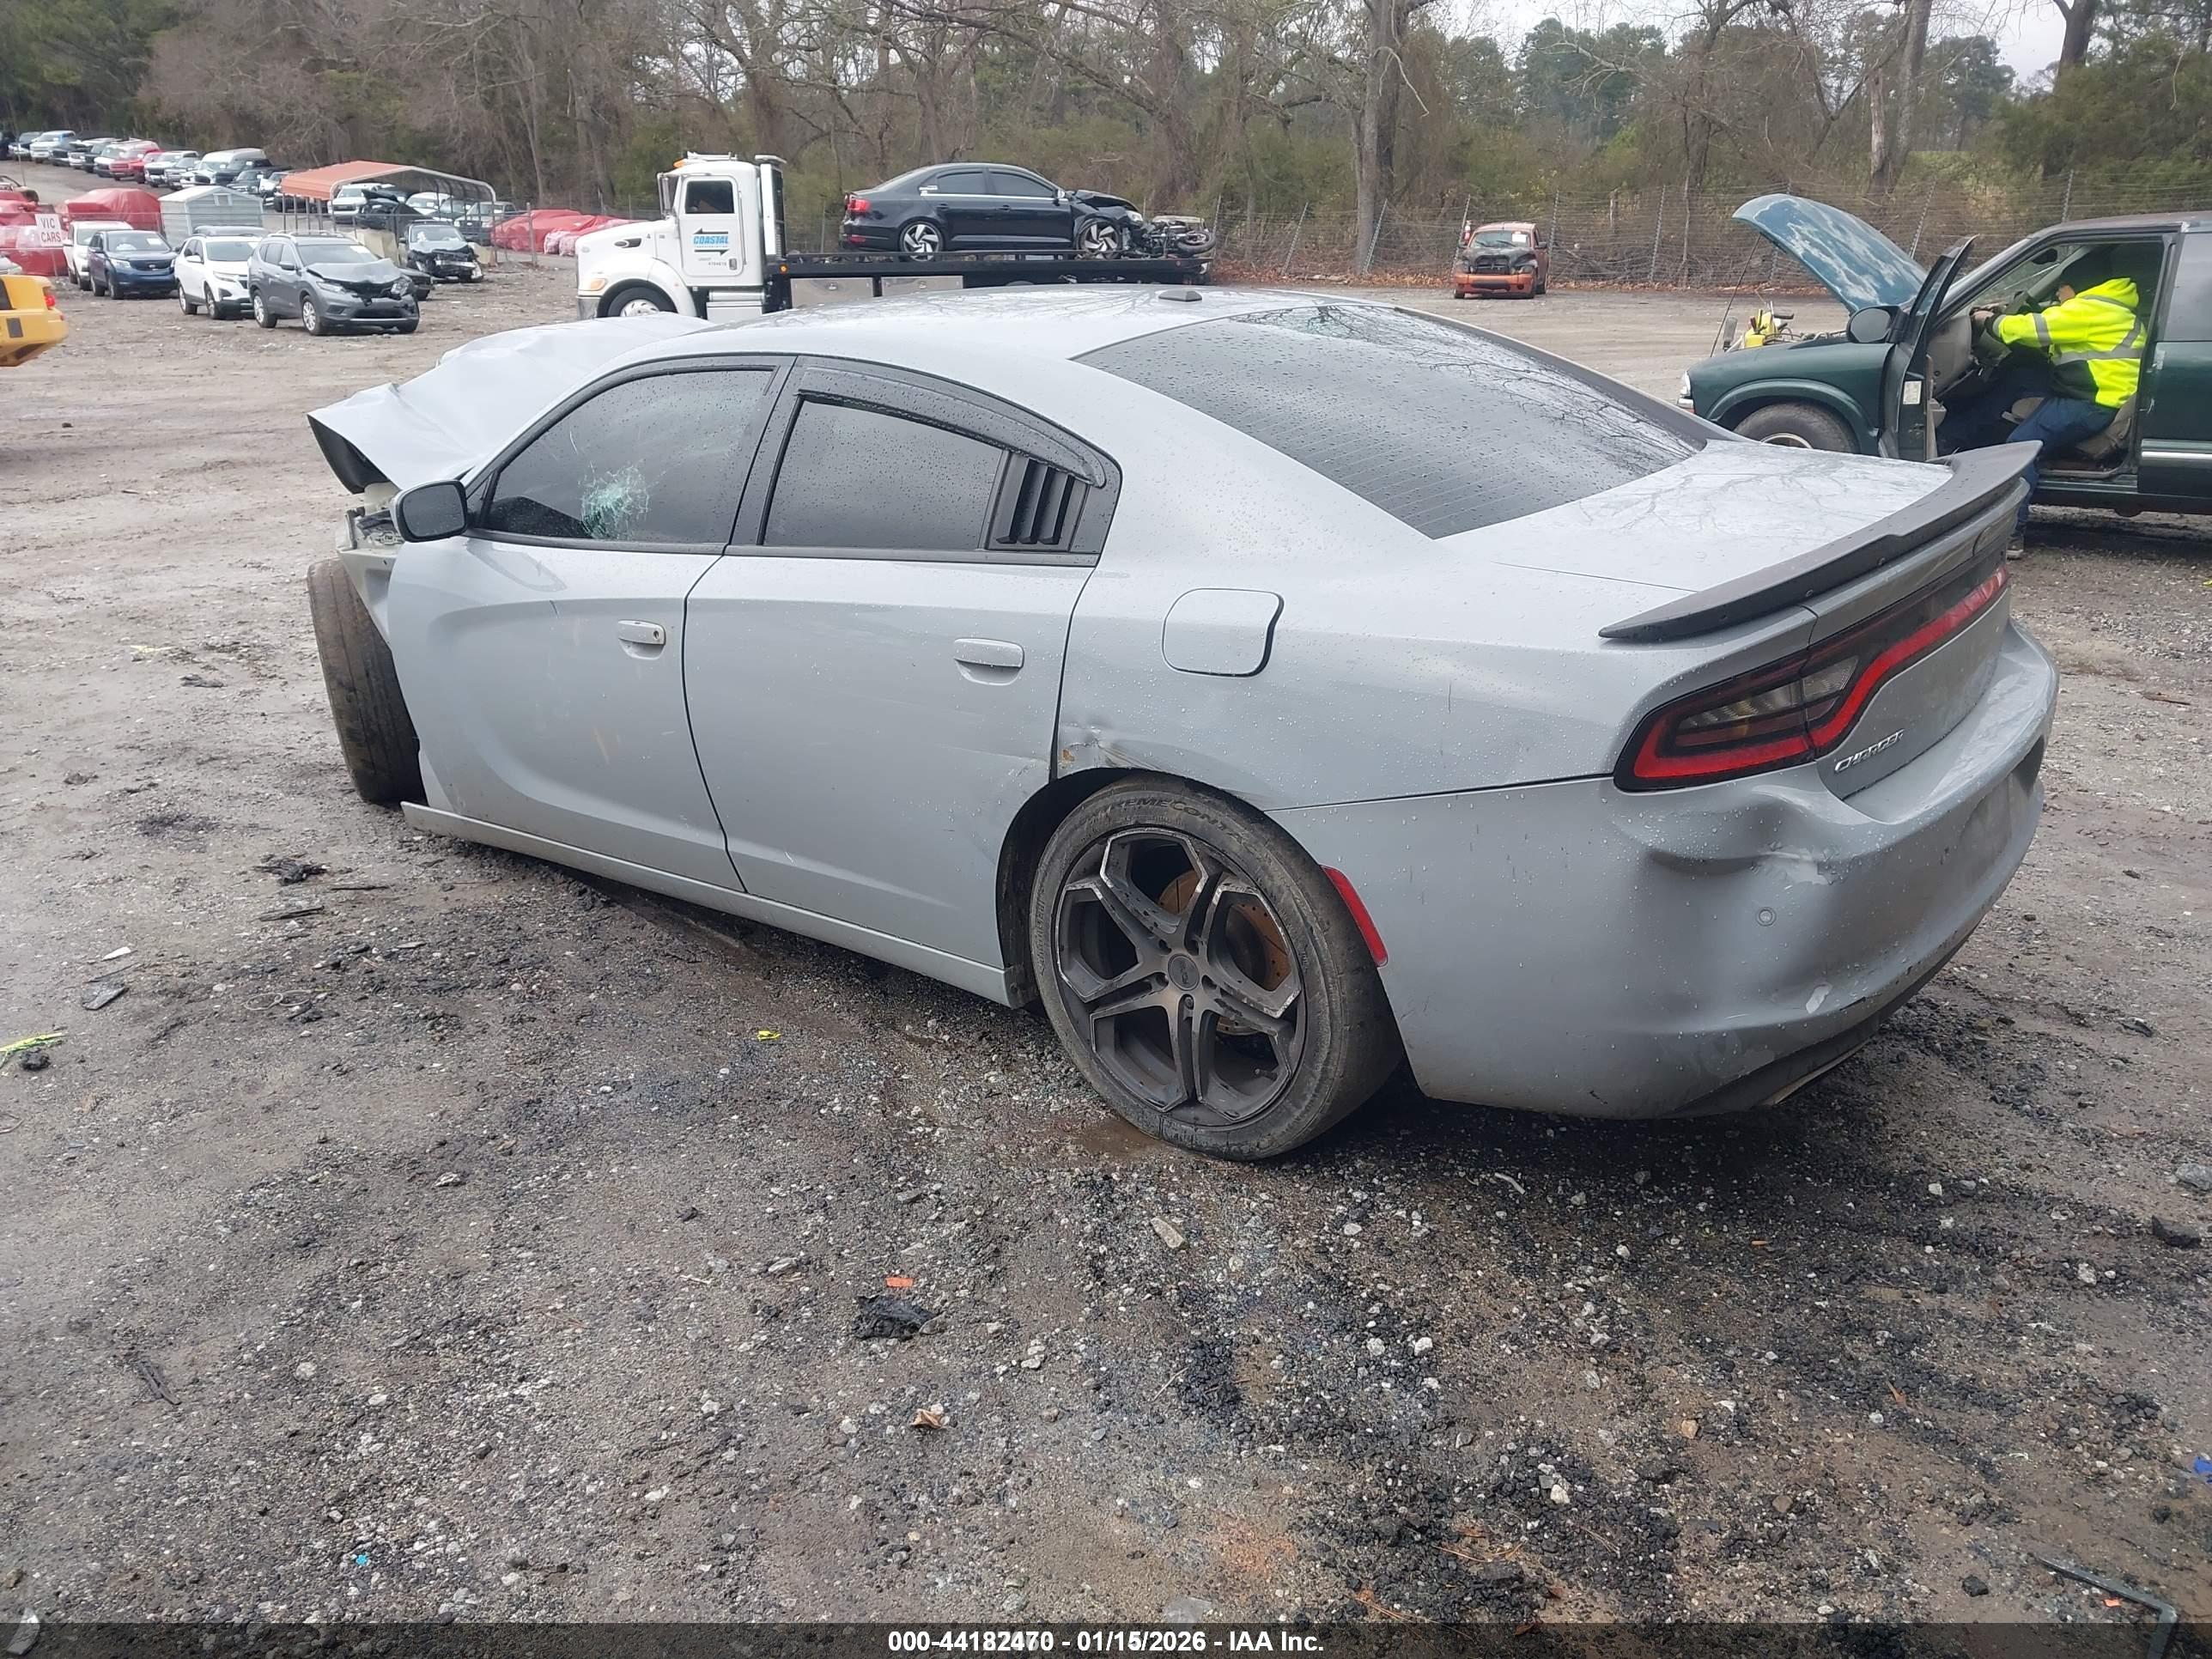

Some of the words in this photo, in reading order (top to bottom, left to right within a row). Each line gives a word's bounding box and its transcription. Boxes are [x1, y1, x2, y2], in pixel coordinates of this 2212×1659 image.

[40, 217, 55, 228] VIC
[41, 232, 62, 242] CARS
[693, 235, 729, 245] COASTAL
